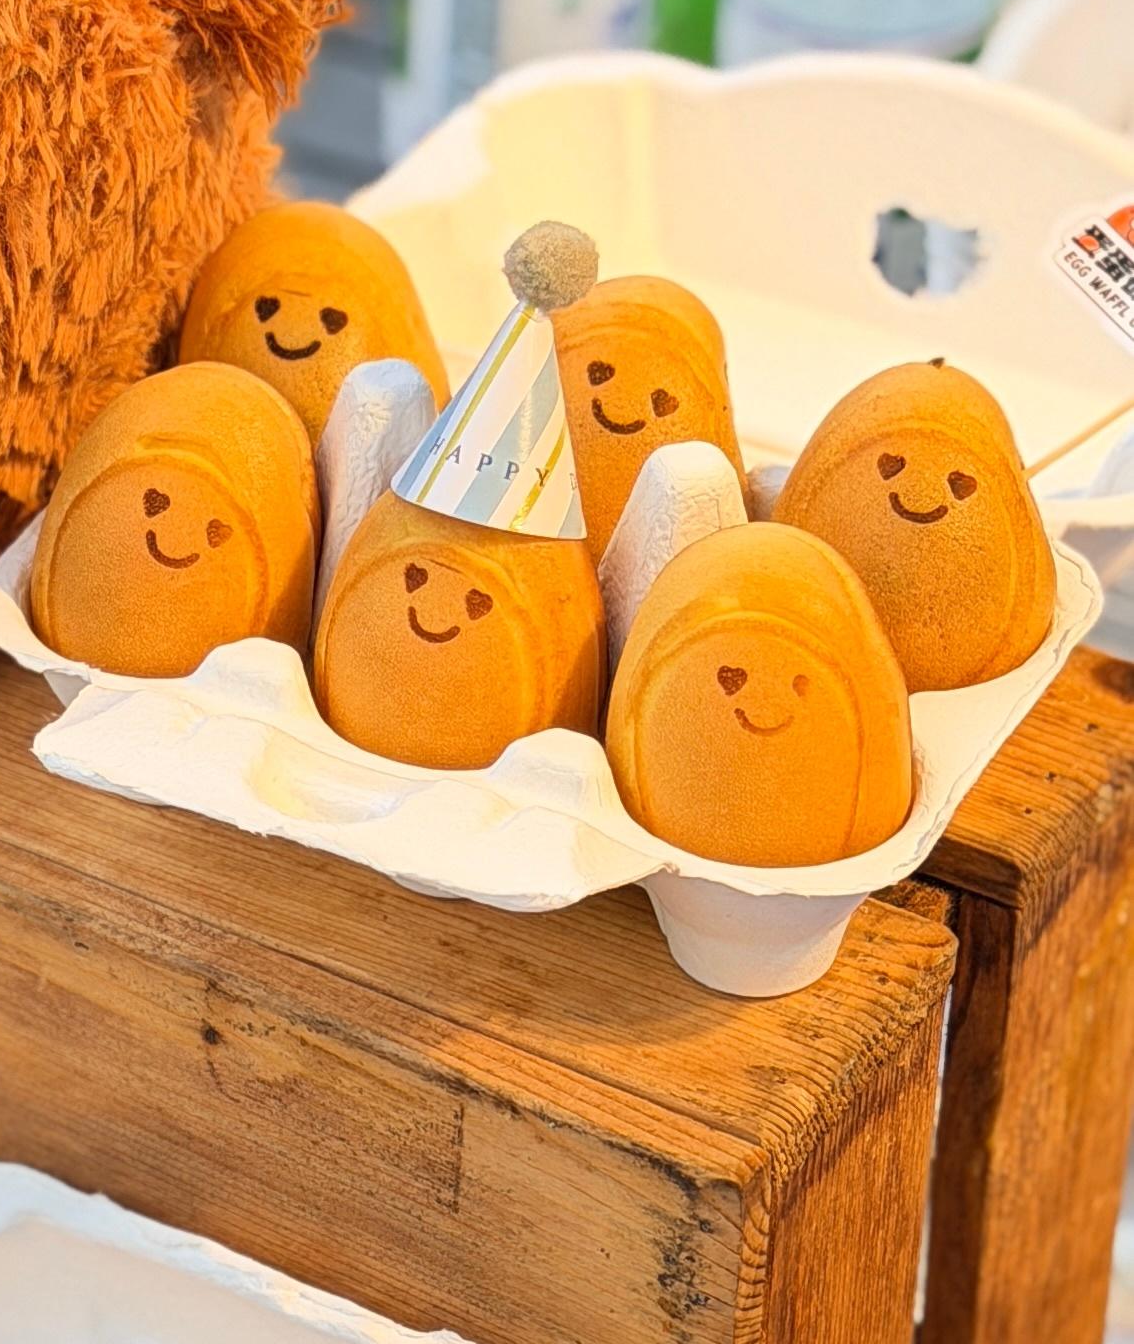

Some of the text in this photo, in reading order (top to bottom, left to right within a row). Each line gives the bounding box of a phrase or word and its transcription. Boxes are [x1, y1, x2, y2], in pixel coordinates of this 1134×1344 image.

[1064, 251, 1130, 318] EGG WAFFL
[429, 436, 550, 487] HAPPY
